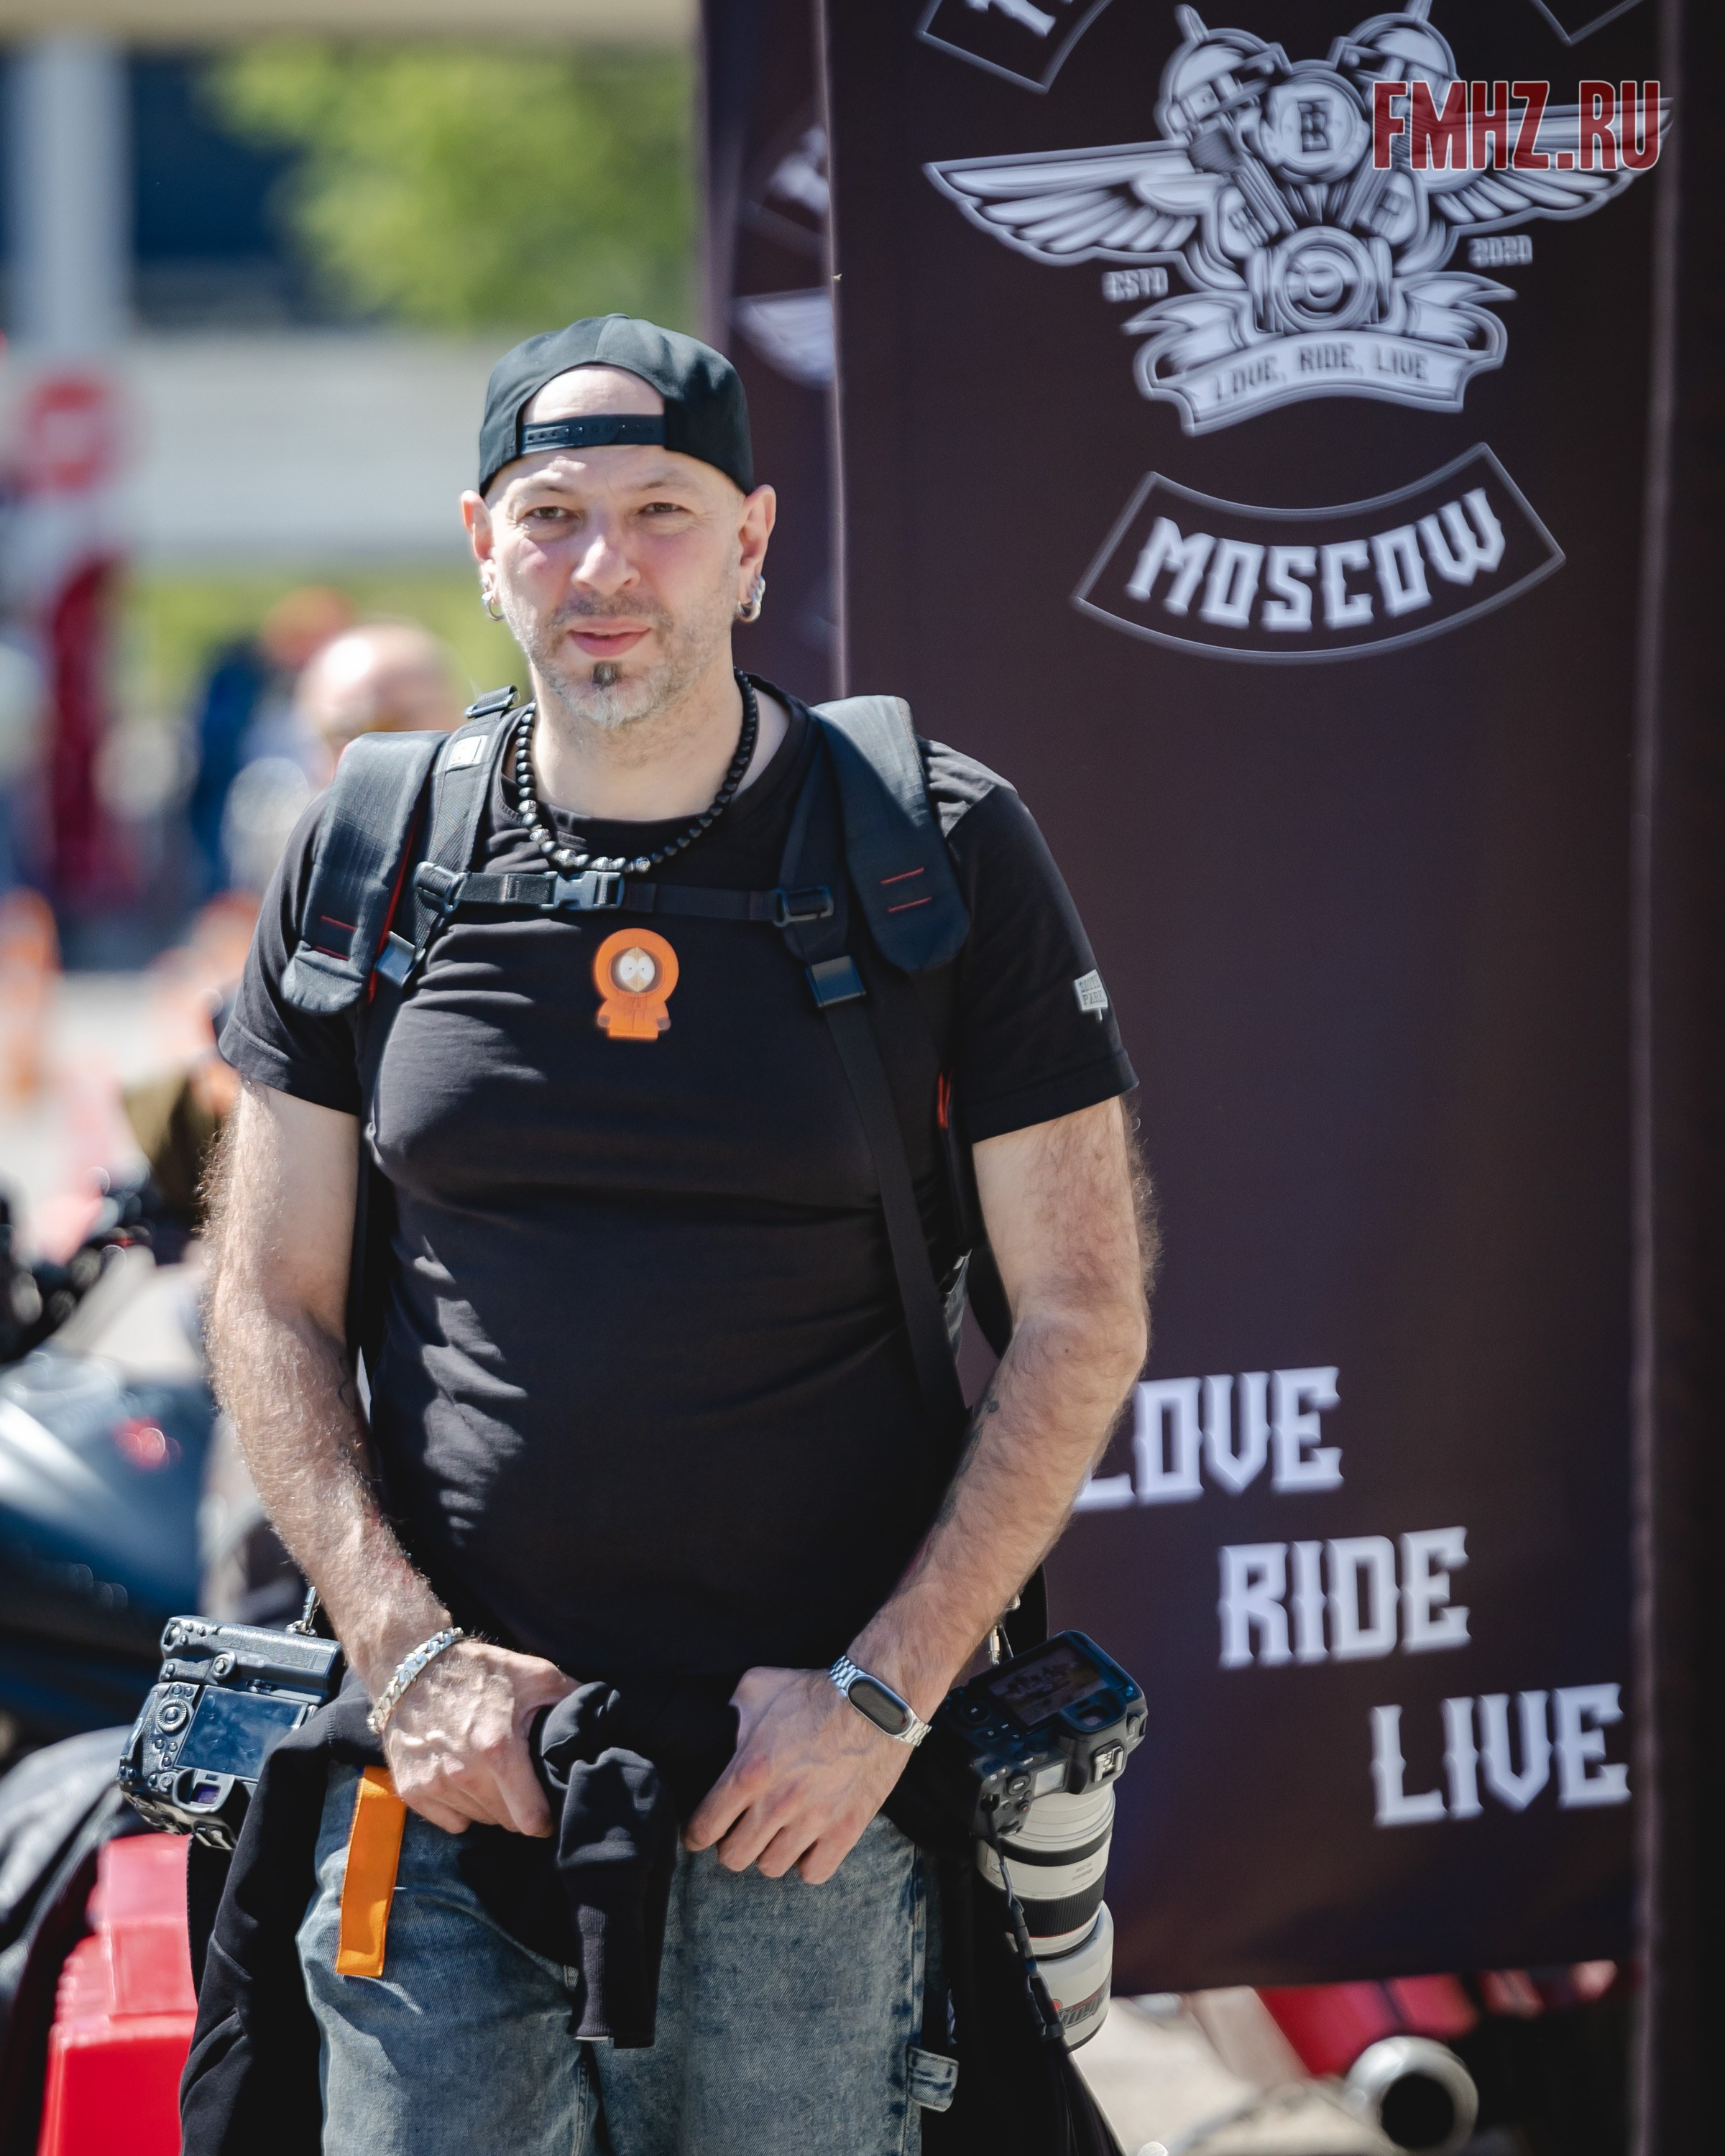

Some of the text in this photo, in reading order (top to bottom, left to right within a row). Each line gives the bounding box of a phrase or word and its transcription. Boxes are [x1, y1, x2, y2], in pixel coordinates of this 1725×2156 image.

[1297, 341, 1364, 376] RIDE,
[1373, 343, 1430, 382] LIVE
[1124, 487, 1506, 632] MOSCOW
[1082, 990, 1106, 1005] PARK
[1218, 1525, 1472, 1669] RIDE
[1371, 1682, 1632, 1830] LIVE
